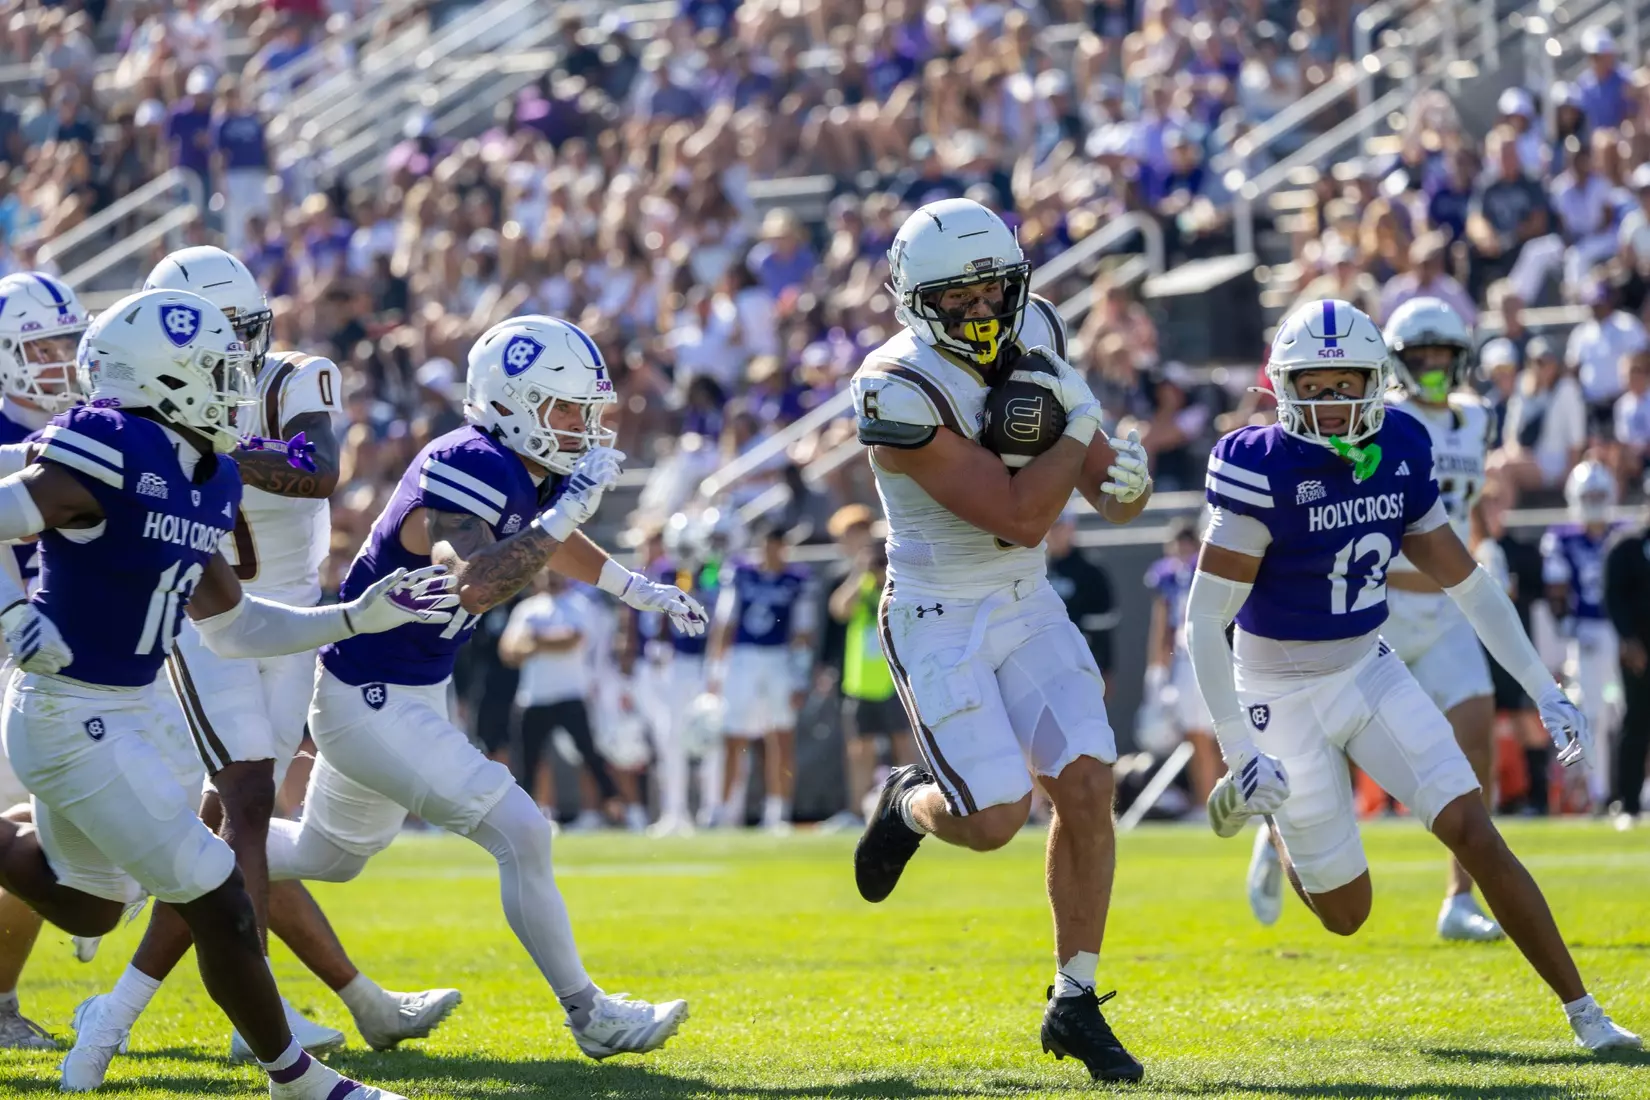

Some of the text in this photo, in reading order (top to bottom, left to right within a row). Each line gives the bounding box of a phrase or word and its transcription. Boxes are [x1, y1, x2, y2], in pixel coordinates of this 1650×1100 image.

[1318, 349, 1345, 358] 508
[318, 370, 335, 406] 0
[596, 381, 612, 393] 508
[265, 468, 316, 497] 570
[143, 511, 190, 546] HOLY
[1327, 532, 1392, 615] 12
